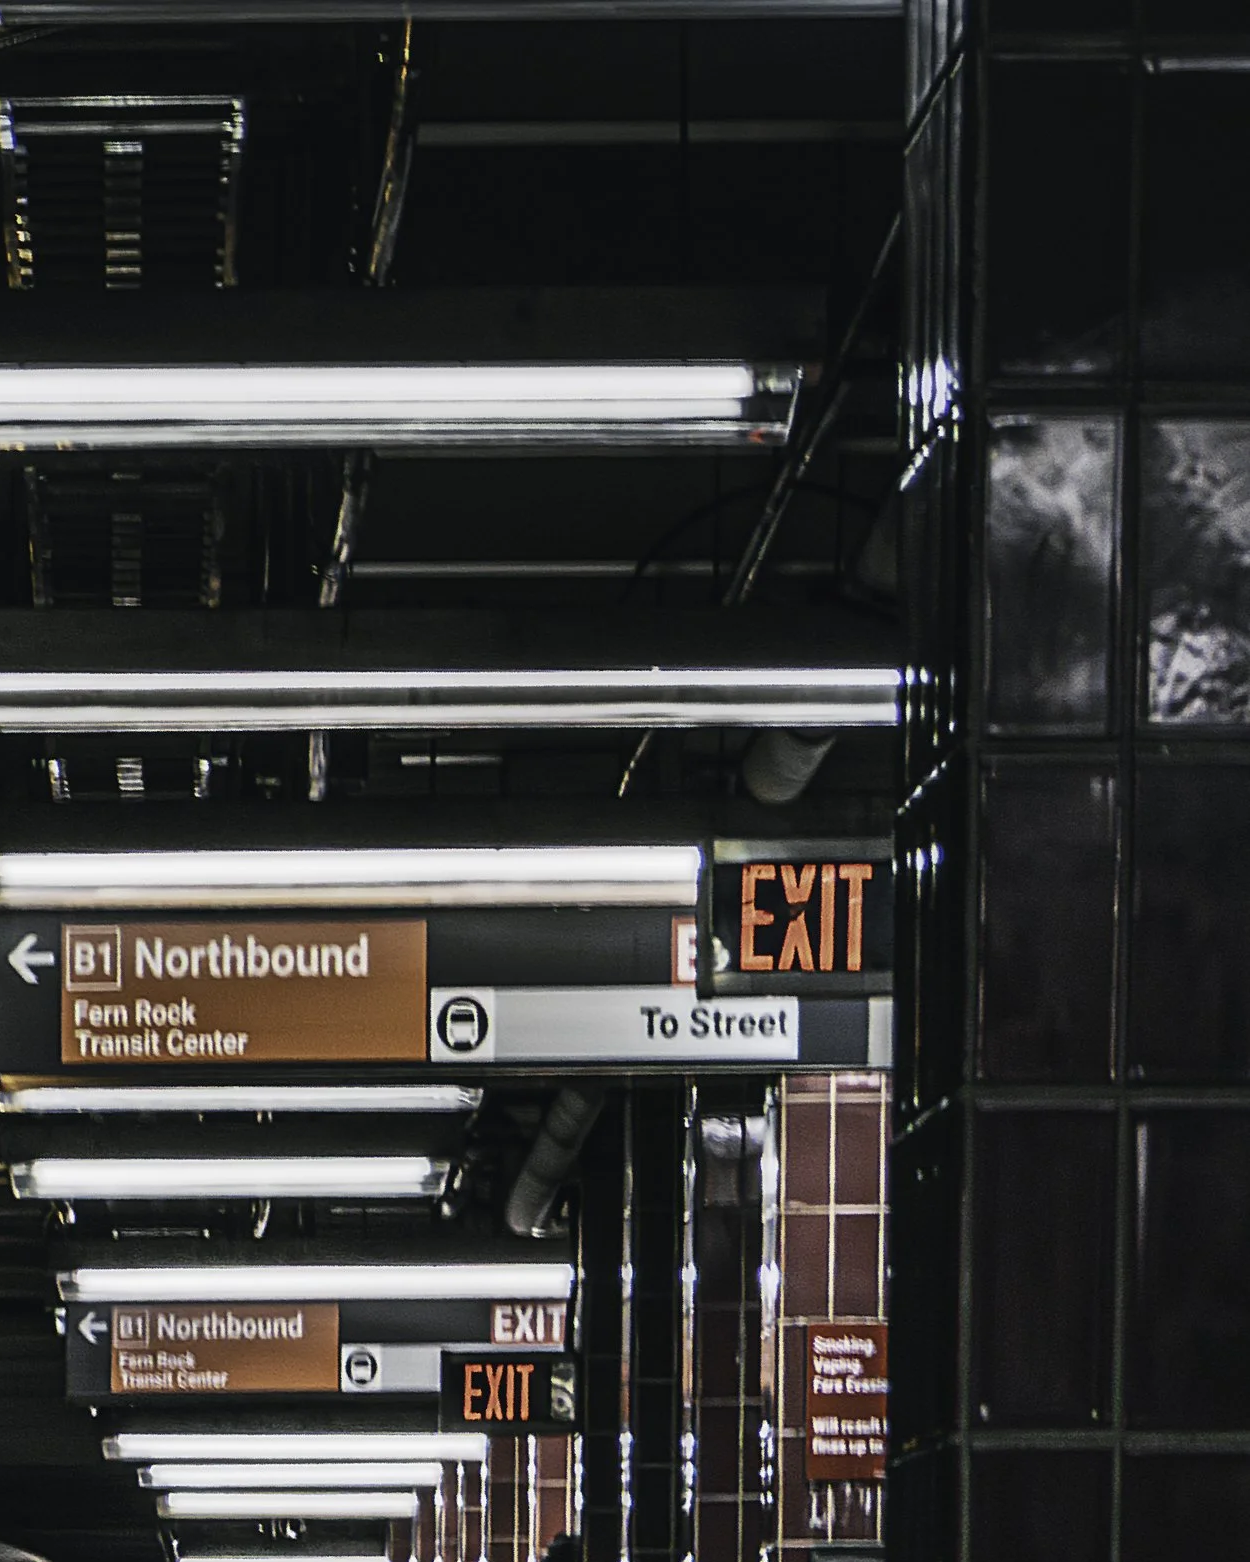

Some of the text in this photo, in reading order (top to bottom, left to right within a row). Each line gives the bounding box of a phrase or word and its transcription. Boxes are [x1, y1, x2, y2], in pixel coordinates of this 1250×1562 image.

[740, 863, 872, 971] EXIT
[75, 934, 368, 979] B1 Northbound
[74, 996, 197, 1027] Fern Rock
[640, 1006, 787, 1039] To Street
[75, 1028, 249, 1057] Transit Center
[157, 1311, 304, 1341] Northbound
[494, 1302, 566, 1344] EXIT
[463, 1363, 535, 1421] EXIT
